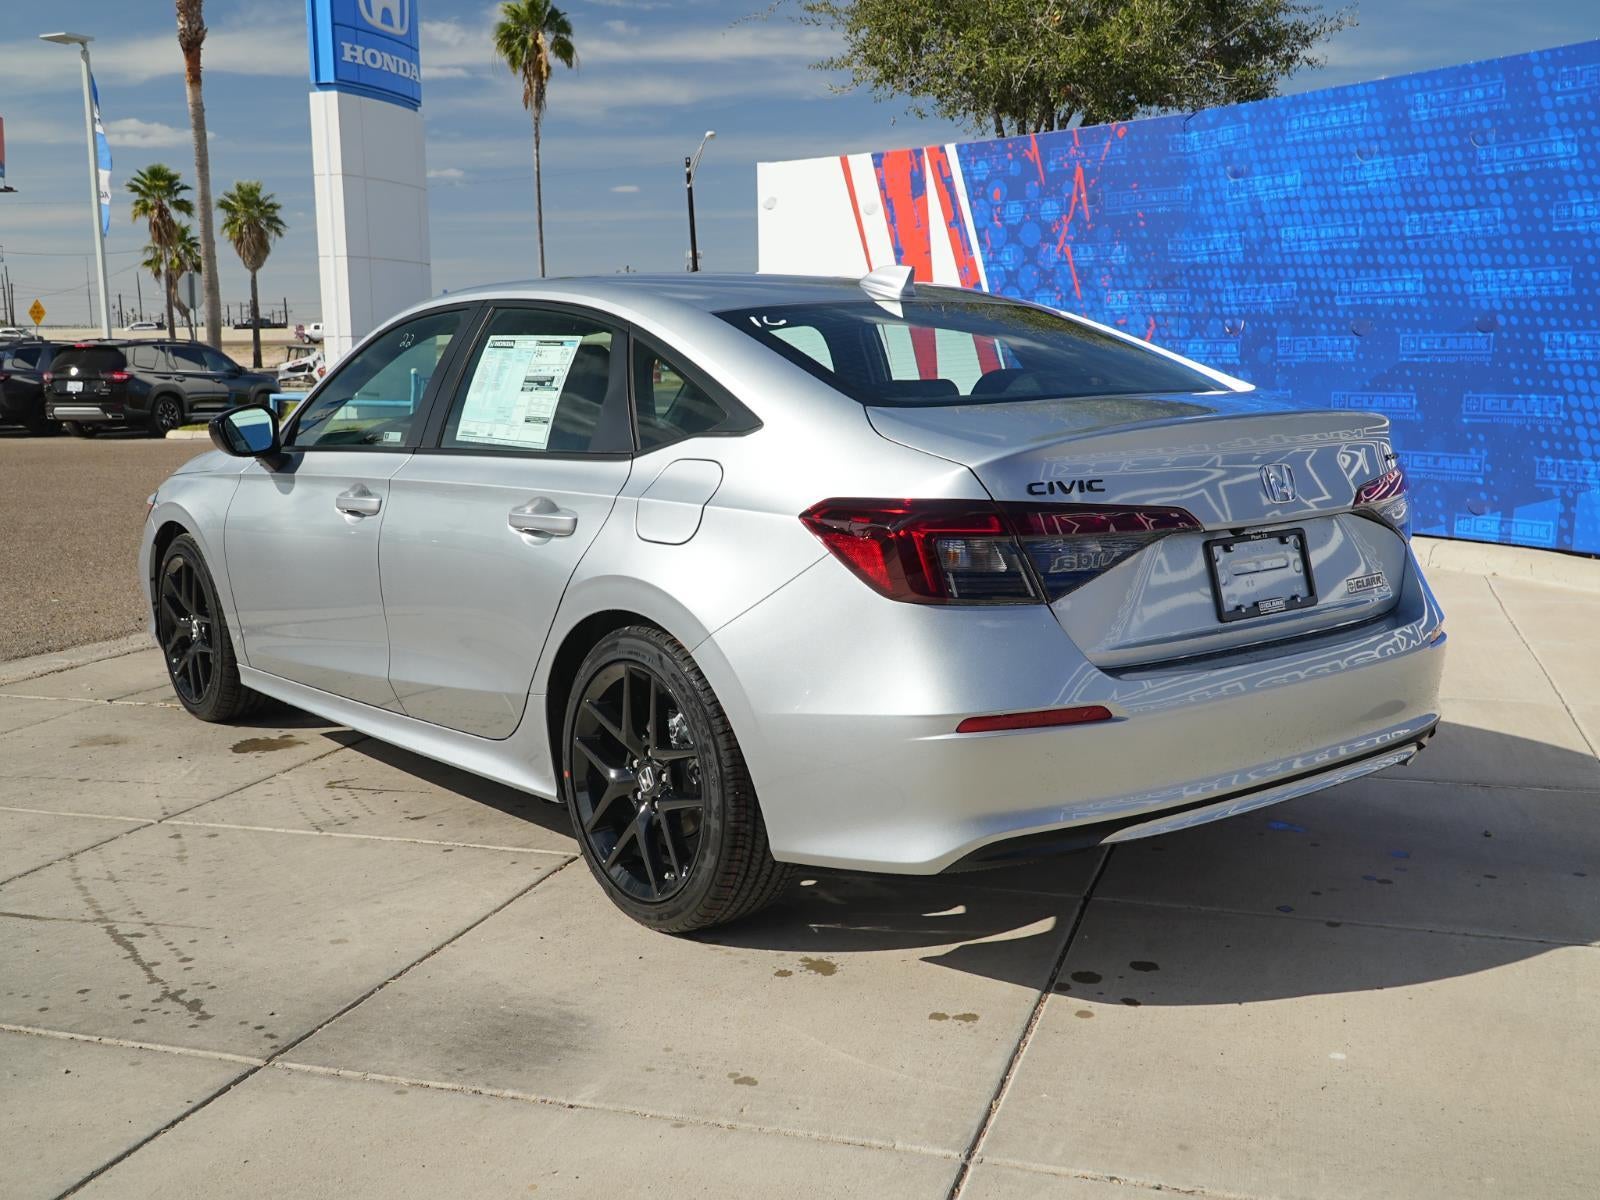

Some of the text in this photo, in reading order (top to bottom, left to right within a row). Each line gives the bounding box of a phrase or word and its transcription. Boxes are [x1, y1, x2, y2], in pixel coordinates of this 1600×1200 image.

[340, 41, 421, 84] HONDA
[1421, 335, 1489, 350] CLARK
[1460, 354, 1492, 362] Honda
[1350, 395, 1411, 409] CLARK
[1484, 397, 1560, 412] CLARK
[1492, 416, 1562, 427] Knapp Honda
[1412, 456, 1480, 470] CLARK
[1026, 479, 1106, 496] CIVIC
[1355, 575, 1382, 589] CLARK
[1265, 599, 1284, 608] CLARK
